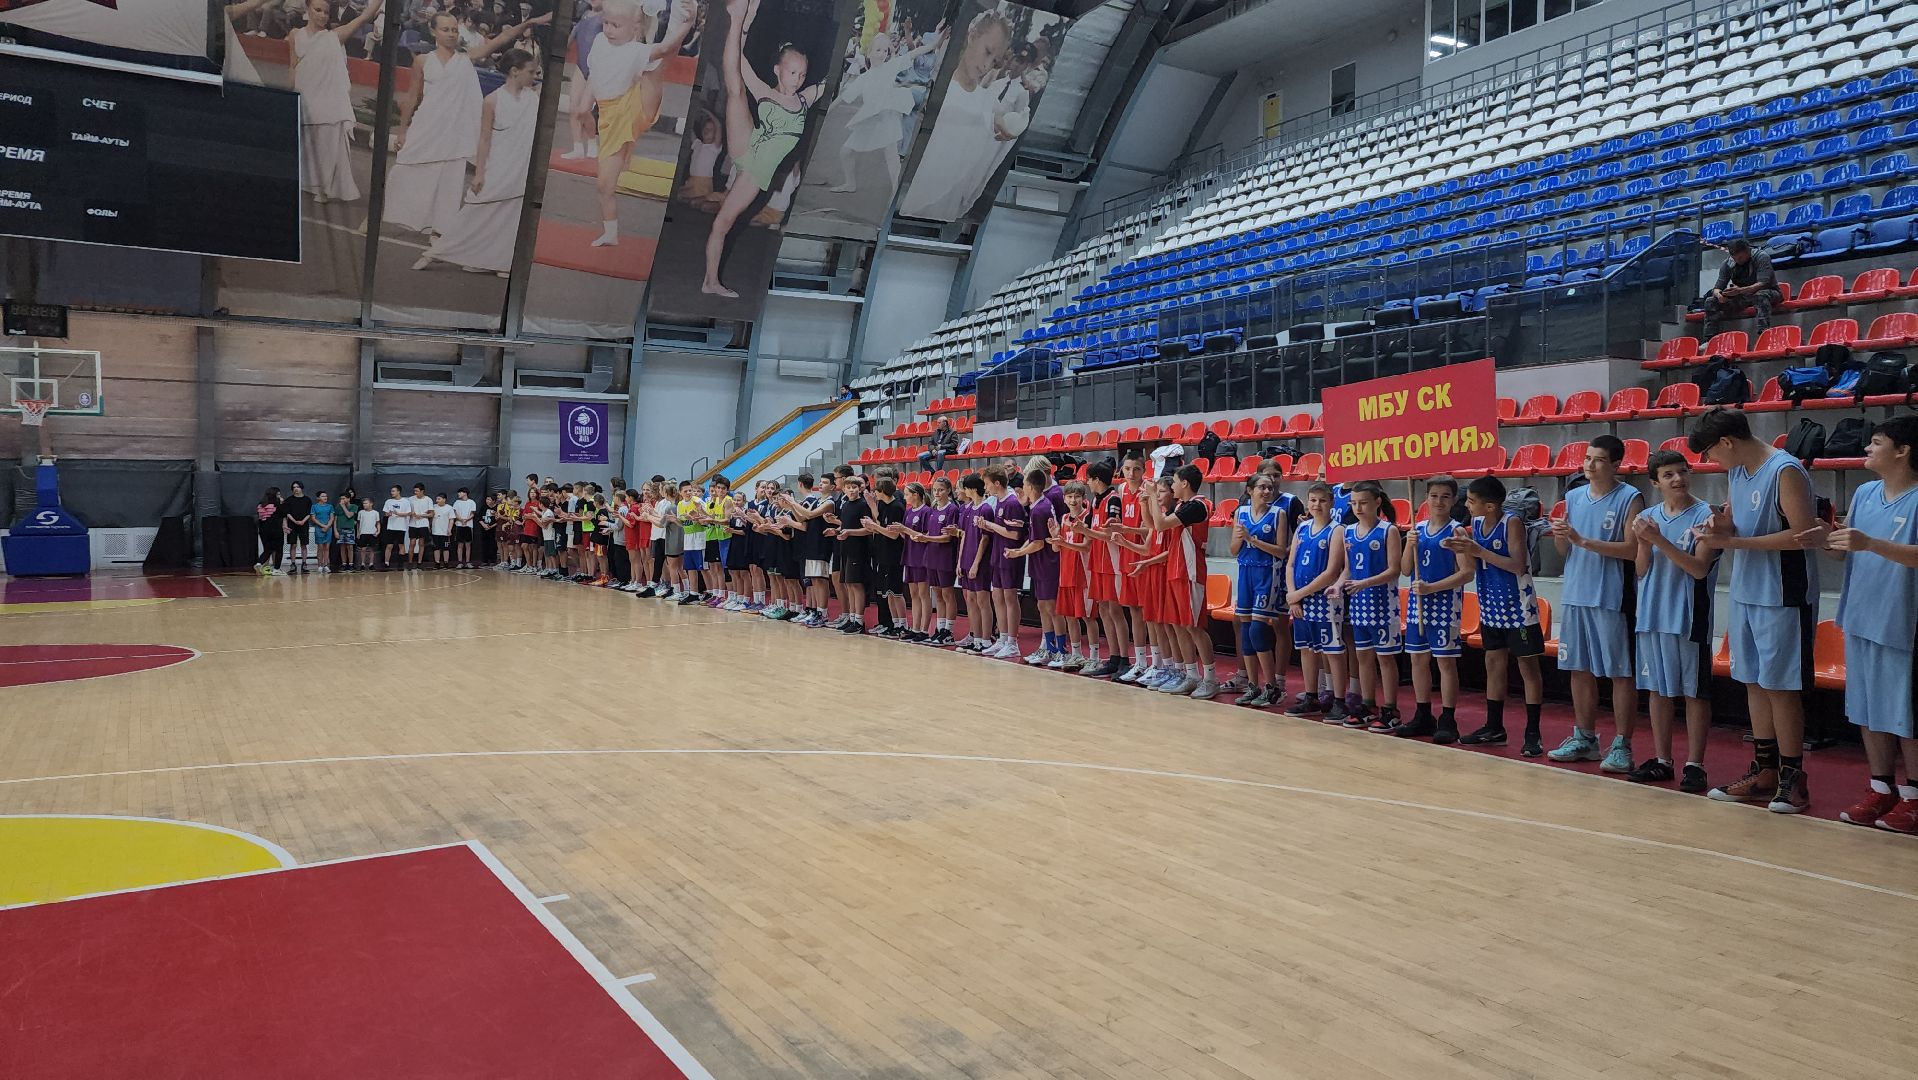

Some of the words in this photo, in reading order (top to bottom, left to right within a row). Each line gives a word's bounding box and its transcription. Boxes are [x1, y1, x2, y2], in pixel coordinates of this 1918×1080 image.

[82, 98, 116, 110] СЧЕТ
[71, 132, 129, 147] ТАЙМ-АУТЫ
[0, 189, 31, 200] РЕМЯ
[86, 208, 118, 218] ФОЛЫ
[1358, 389, 1409, 421] МБУ
[1417, 382, 1452, 411] СК
[1328, 425, 1495, 468] «ВИКТОРИЯ»
[1751, 490, 1761, 512] 9
[1603, 510, 1616, 530] 5
[1890, 516, 1907, 541] 7
[1676, 528, 1691, 550] 4
[1302, 550, 1311, 566] 5
[1355, 552, 1364, 570] 2
[1422, 549, 1431, 567] 3
[1254, 594, 1269, 609] 13
[1320, 628, 1329, 645] 5
[1377, 628, 1387, 645] 2
[1437, 629, 1447, 647] 3
